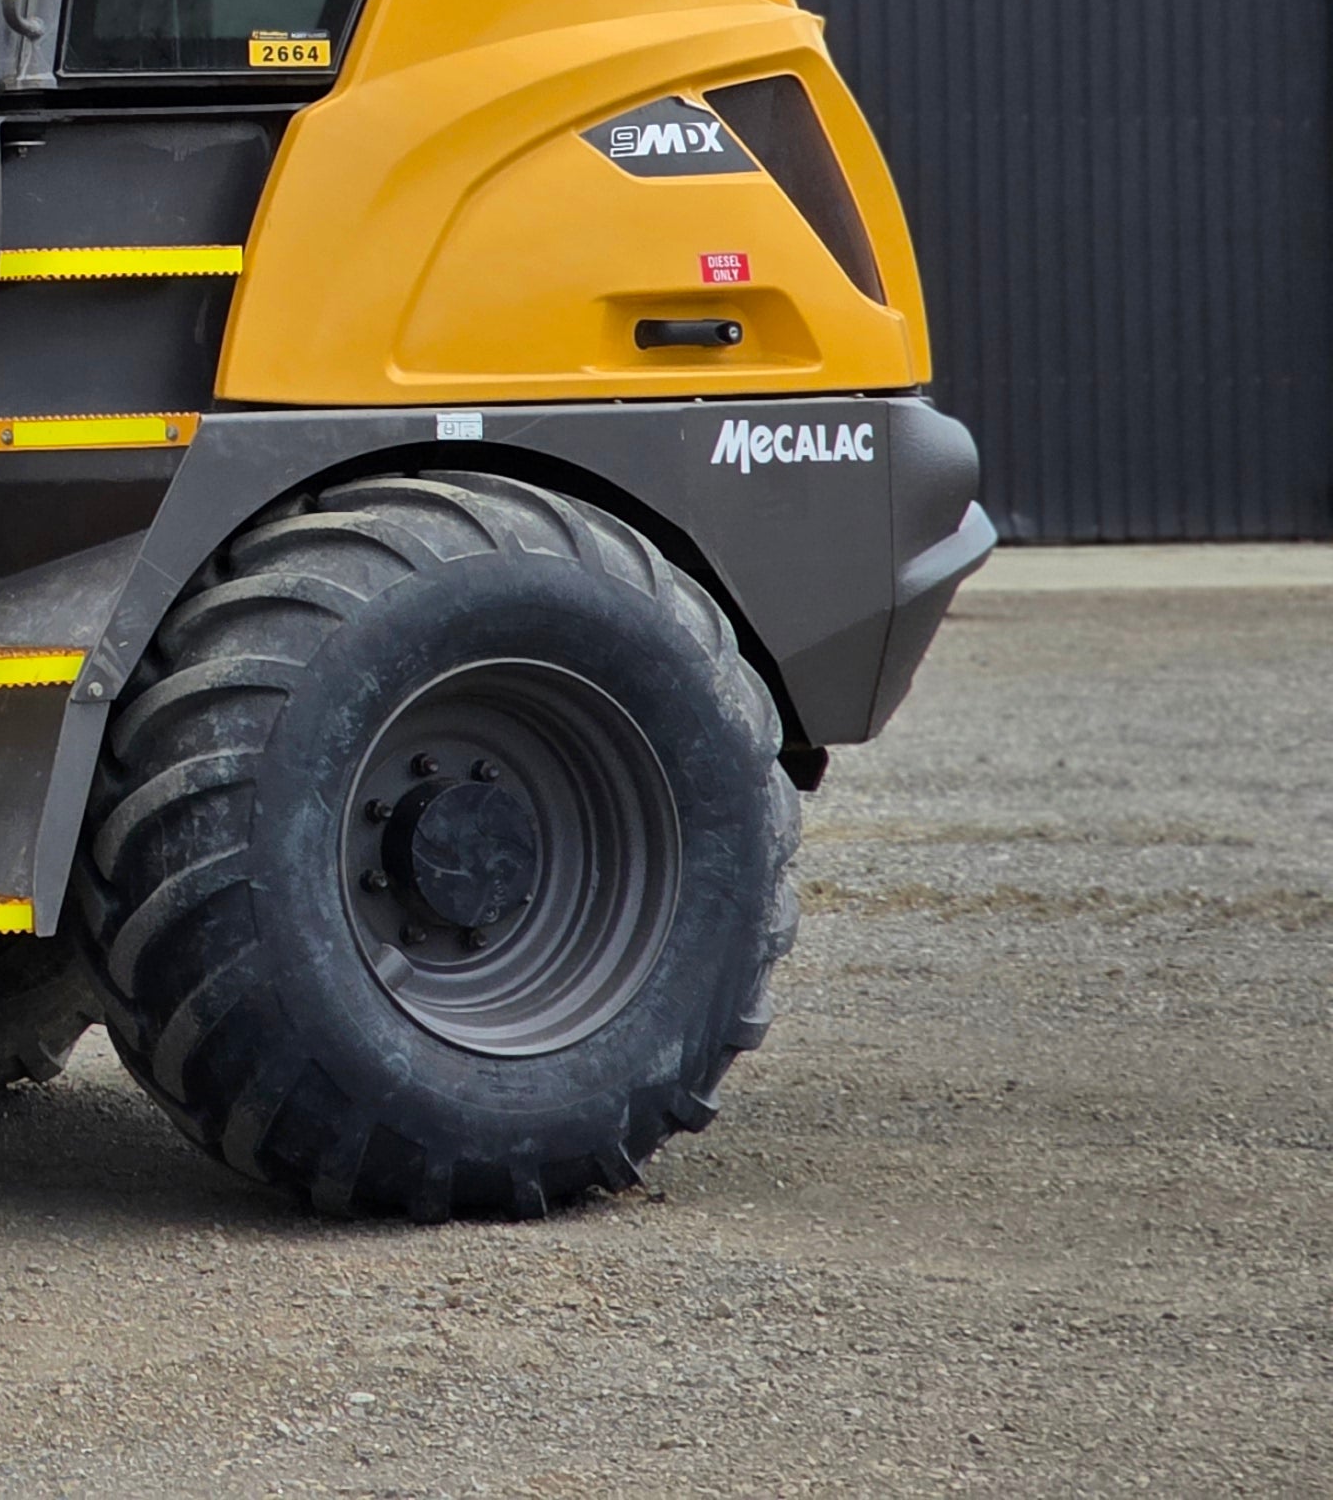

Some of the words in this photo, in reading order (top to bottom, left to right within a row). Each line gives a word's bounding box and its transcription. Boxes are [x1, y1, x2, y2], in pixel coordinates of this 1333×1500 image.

[263, 45, 319, 62] 2664
[610, 122, 724, 157] 9MDX
[708, 255, 741, 268] DIESEL
[713, 269, 739, 281] ONLY
